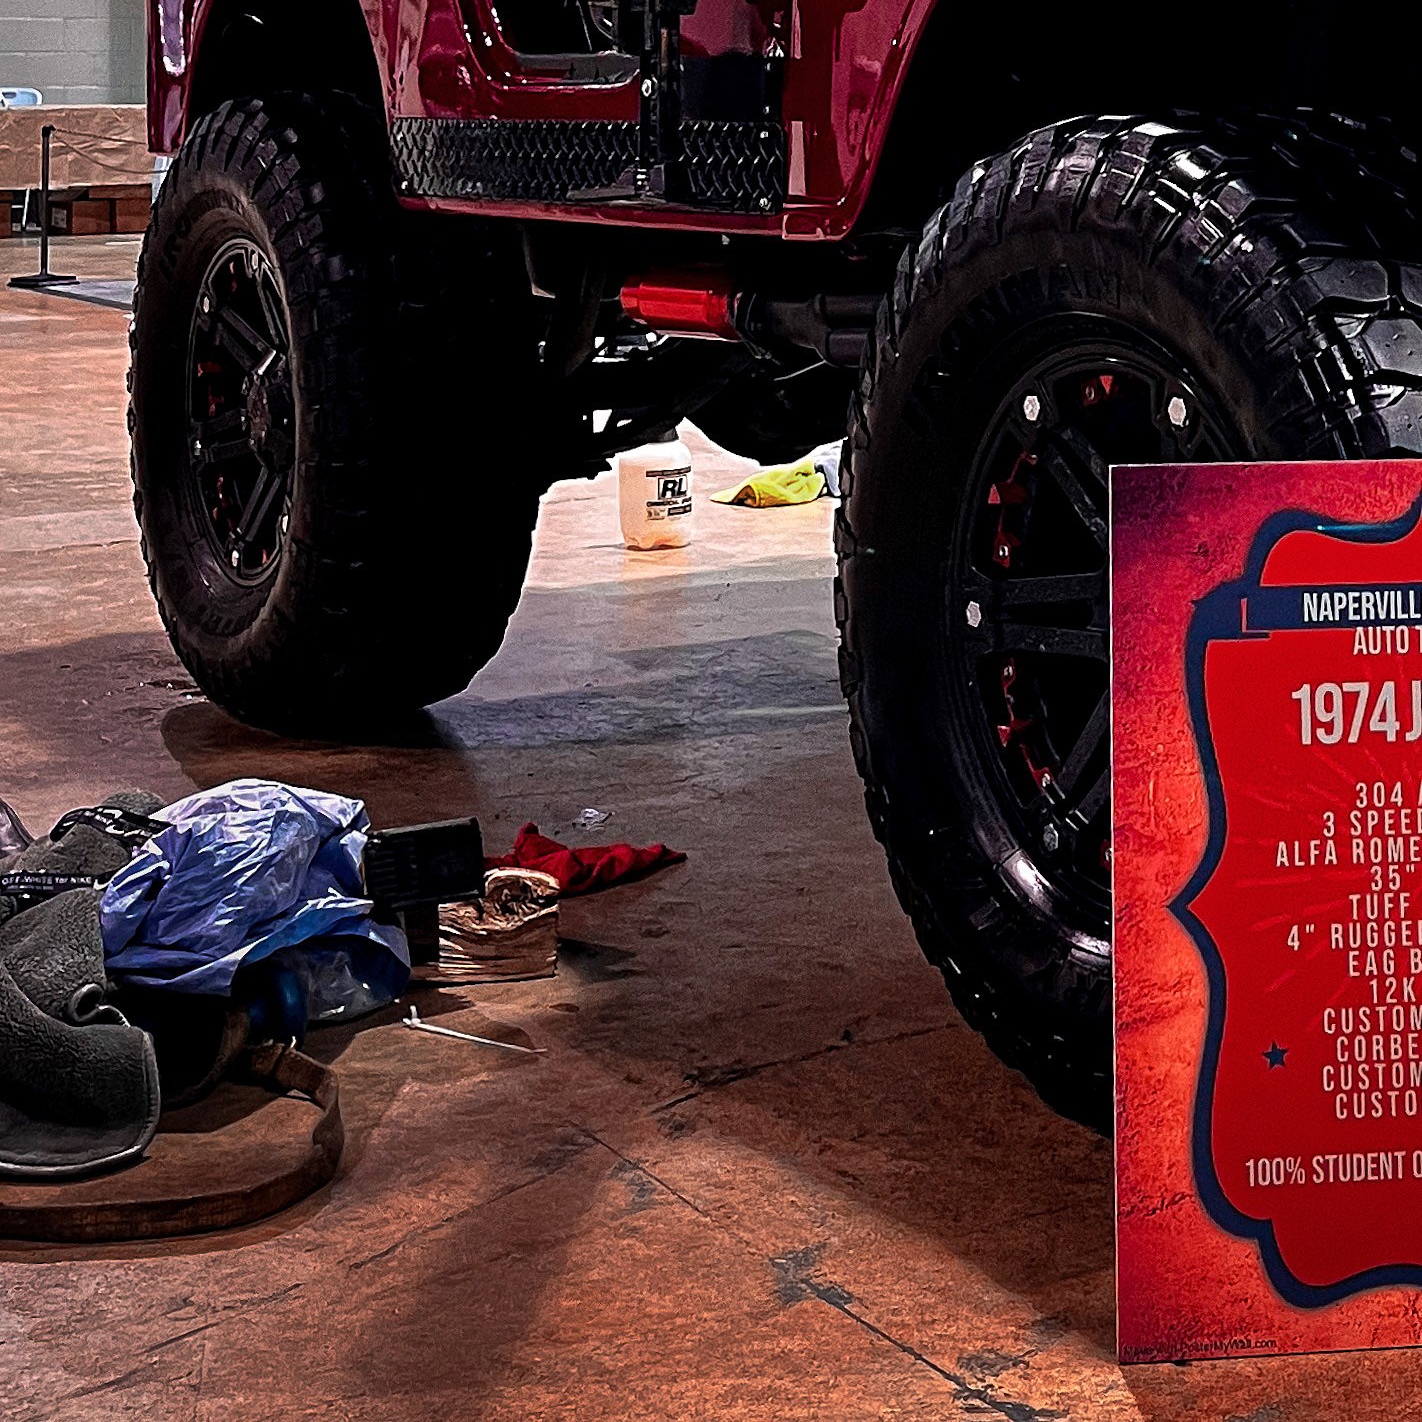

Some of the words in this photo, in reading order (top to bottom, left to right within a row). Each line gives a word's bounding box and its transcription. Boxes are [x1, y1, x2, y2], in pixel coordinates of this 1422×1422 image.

[661, 478, 687, 499] RL
[1354, 625, 1408, 655] AUTO
[1292, 681, 1400, 744] 1974
[1356, 782, 1402, 808] 304
[1323, 812, 1334, 837] 3
[1277, 840, 1337, 866] ALFA
[1371, 864, 1414, 891] 35"
[1349, 893, 1410, 920] TUFF
[1288, 924, 1314, 950] 4"
[1349, 949, 1394, 976] EAG
[1370, 977, 1415, 1003] 12K
[1246, 1158, 1305, 1186] 100%
[1313, 1152, 1405, 1183] STUDENT
